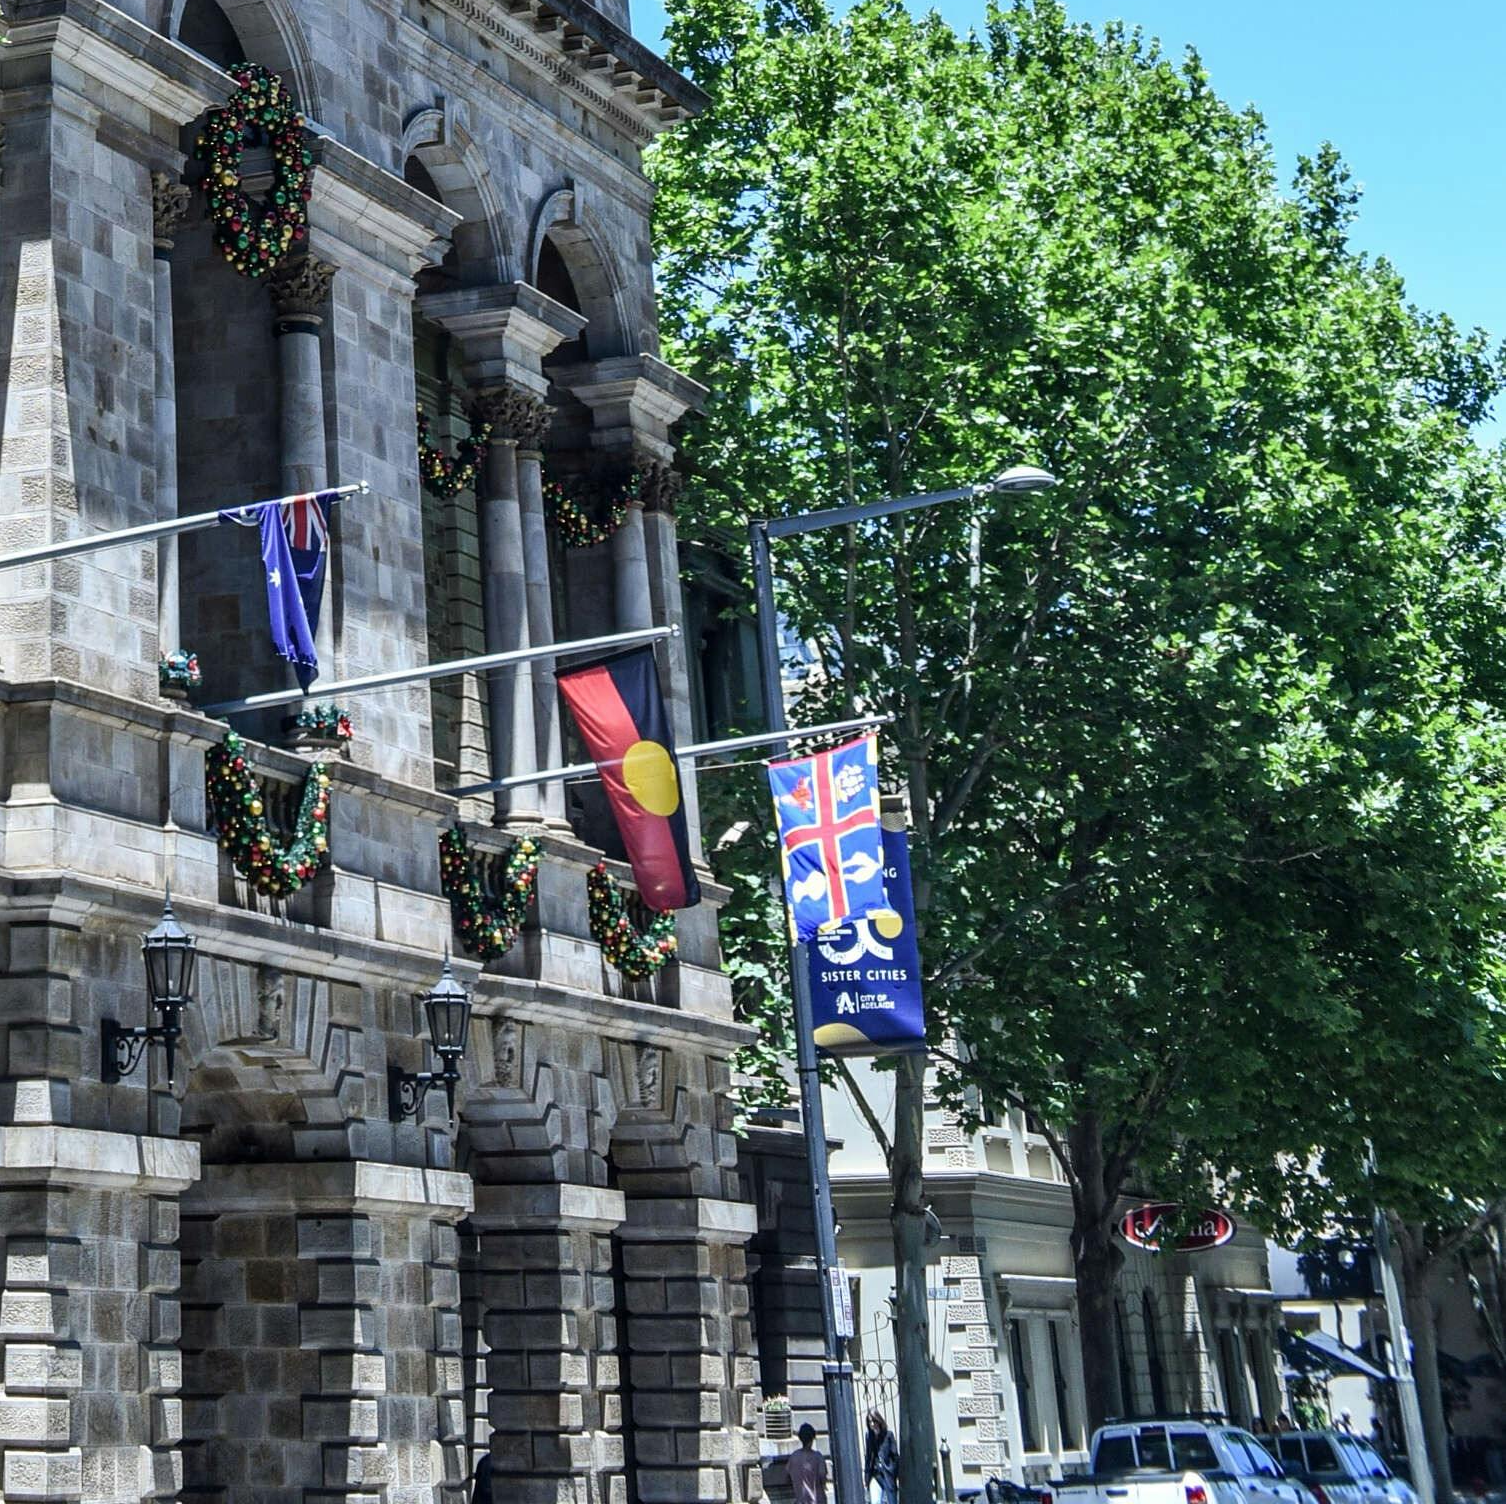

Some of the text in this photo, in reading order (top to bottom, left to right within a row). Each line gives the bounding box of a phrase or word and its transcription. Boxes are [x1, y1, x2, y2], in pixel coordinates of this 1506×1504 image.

[821, 969, 907, 983] SISTER CITIES
[860, 994, 876, 1002] CITY
[860, 1001, 895, 1010] ADELAIDE
